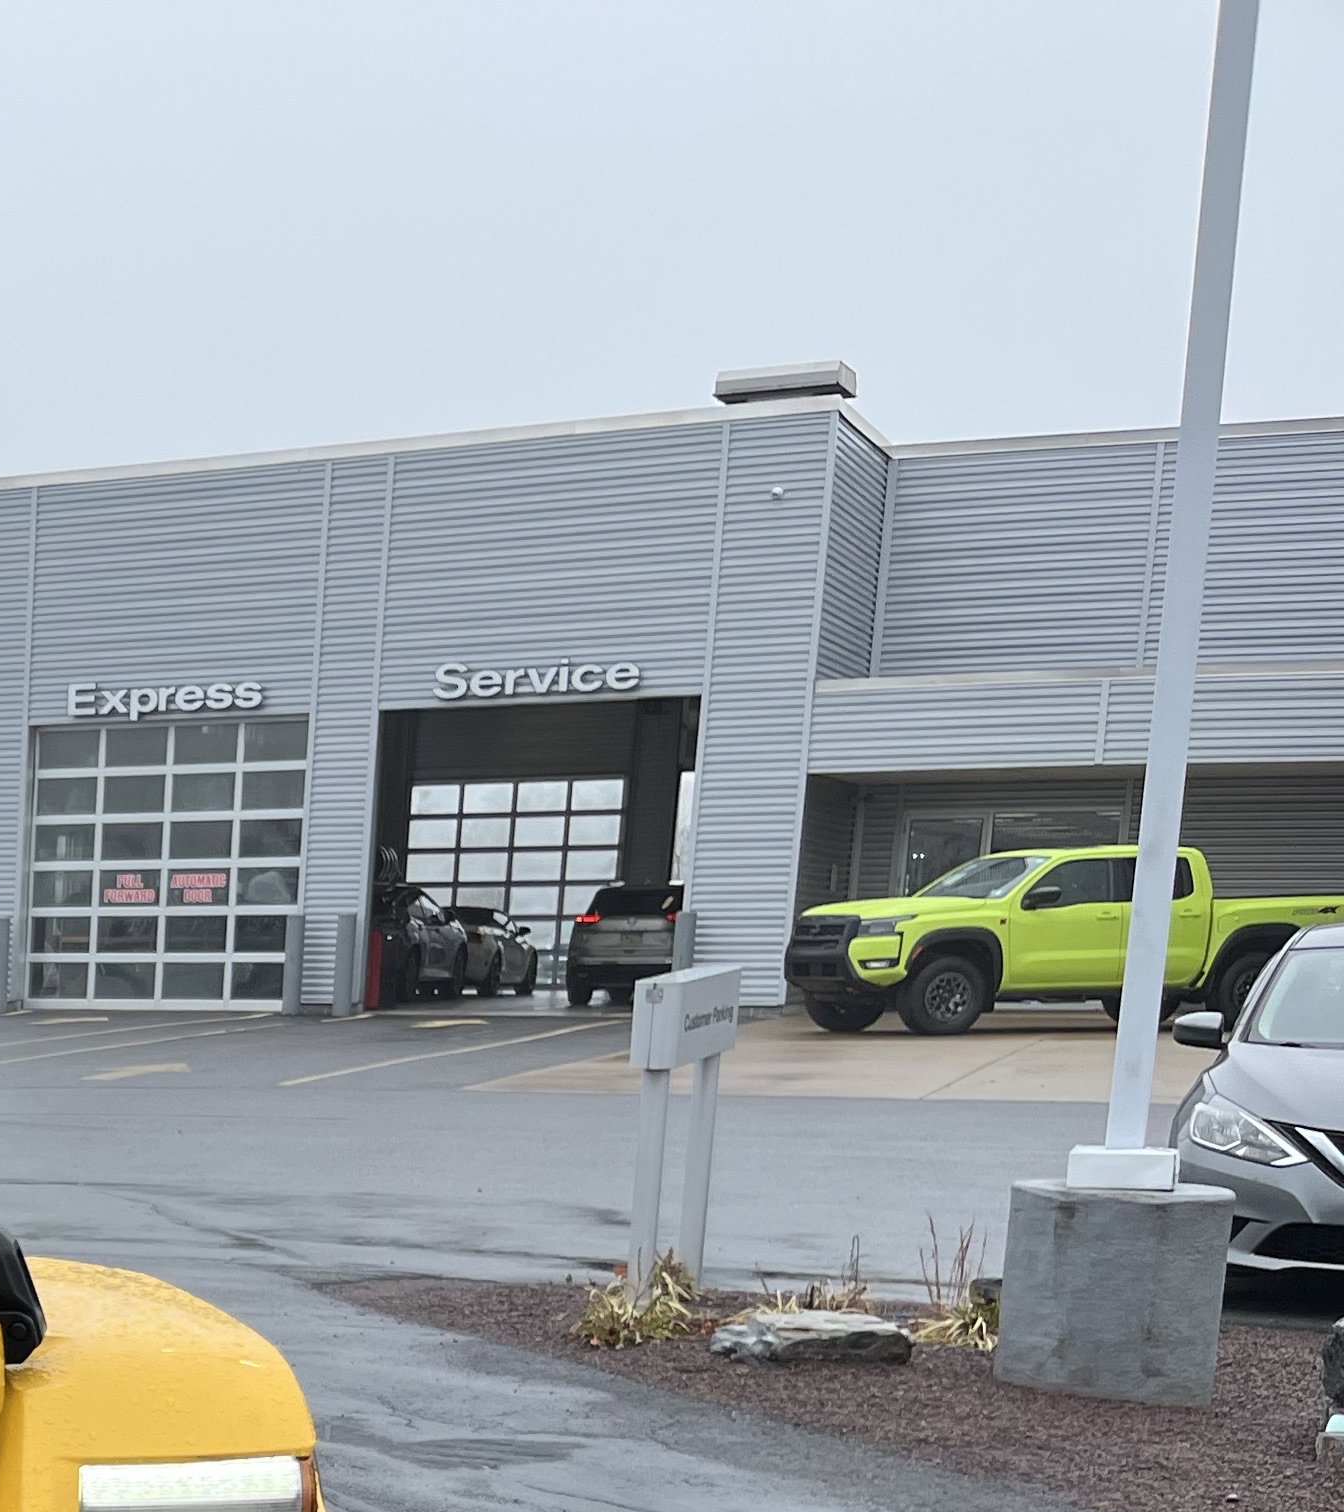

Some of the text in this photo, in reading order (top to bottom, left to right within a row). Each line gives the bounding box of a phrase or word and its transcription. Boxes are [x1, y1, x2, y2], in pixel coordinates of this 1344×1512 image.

[432, 658, 641, 700] Service
[67, 681, 263, 721] Express
[116, 874, 144, 888] PULL
[170, 873, 227, 888] AUTOMATIC
[103, 889, 155, 903] FORWARD
[183, 889, 212, 903] DOOR
[683, 1005, 733, 1033] Customer Parking
